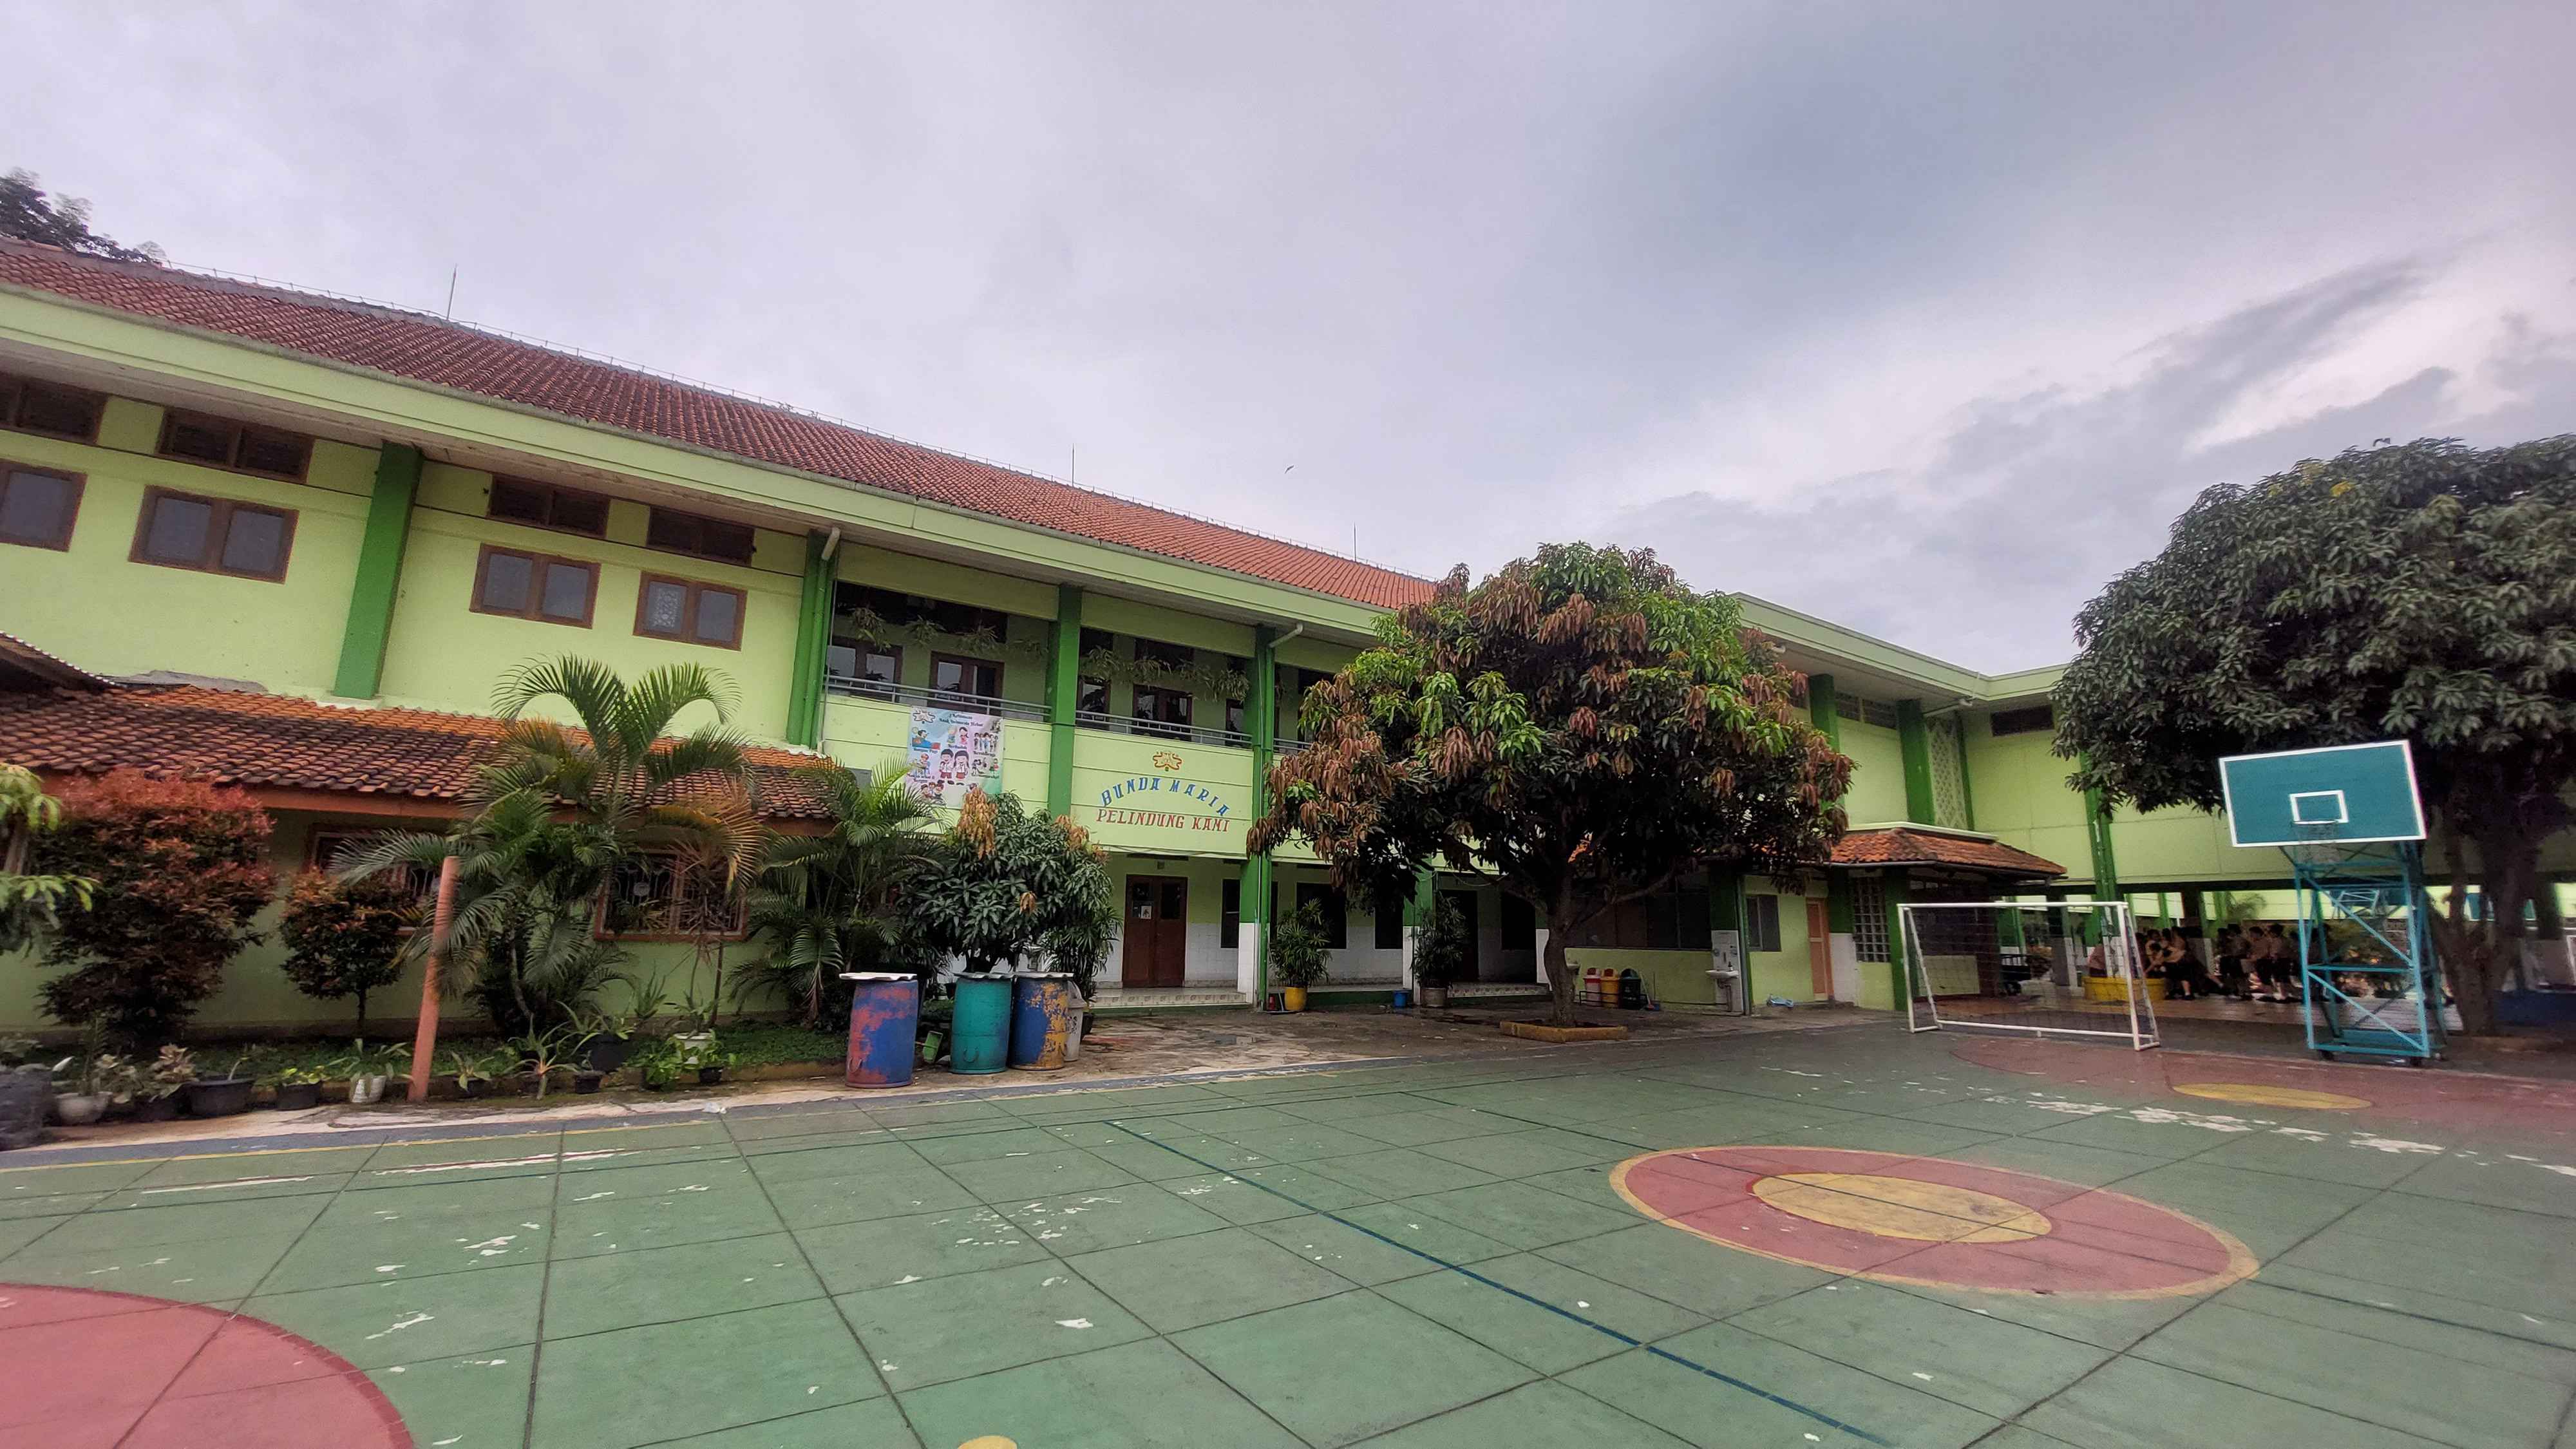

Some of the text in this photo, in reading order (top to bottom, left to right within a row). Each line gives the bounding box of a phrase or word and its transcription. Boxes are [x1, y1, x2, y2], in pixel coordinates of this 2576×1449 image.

[1101, 777, 1229, 817] BUNDA MARIA
[1096, 808, 1230, 832] PELINDUNG KAMI
